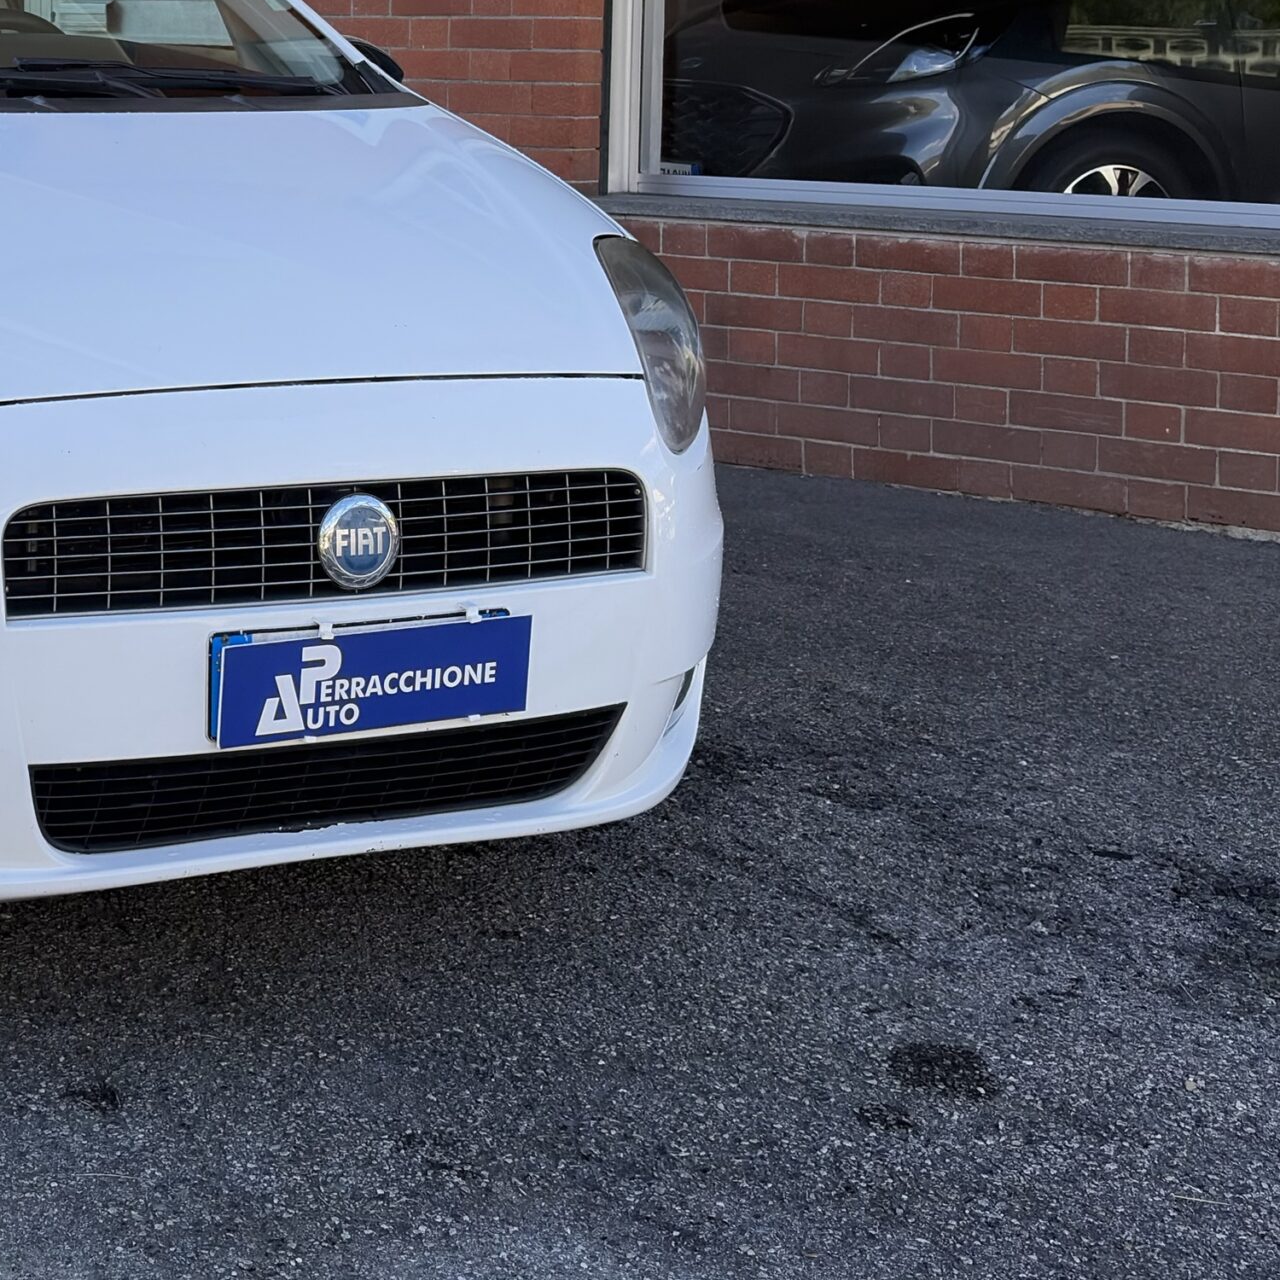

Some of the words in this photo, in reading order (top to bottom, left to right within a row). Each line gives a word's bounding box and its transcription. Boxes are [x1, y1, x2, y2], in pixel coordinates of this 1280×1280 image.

[335, 525, 387, 557] FIAT
[255, 674, 360, 736] AUTO
[299, 644, 497, 705] PERRACCHIONE
